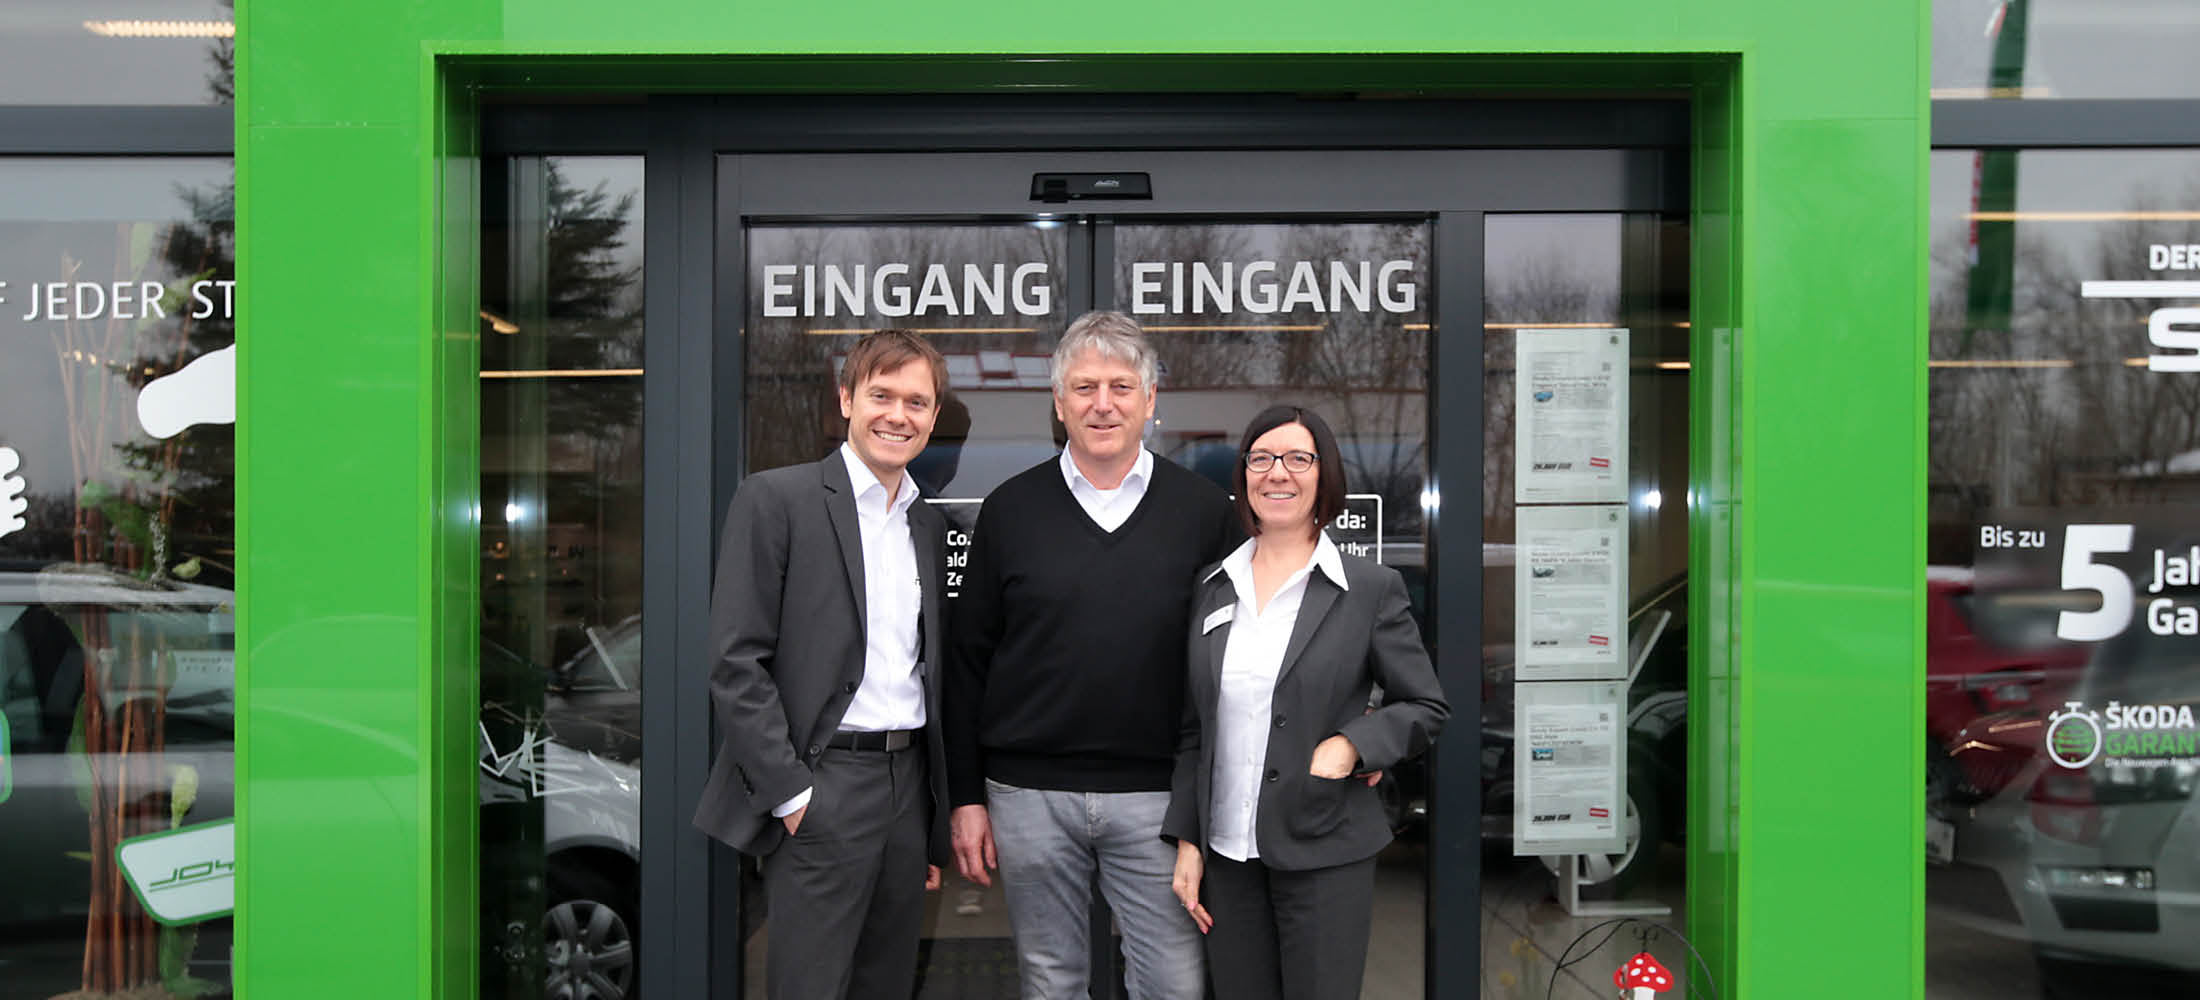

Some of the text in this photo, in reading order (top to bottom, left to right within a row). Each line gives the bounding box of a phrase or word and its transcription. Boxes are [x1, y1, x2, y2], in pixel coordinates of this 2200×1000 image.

[2149, 244, 2200, 270] DER
[22, 281, 166, 321] JEDER
[763, 262, 1051, 317] EINGANG
[1132, 260, 1416, 314] EINGANG
[1980, 525, 2046, 548] Bis zu
[2056, 524, 2135, 642] 5
[2105, 700, 2196, 730] ŠKODA
